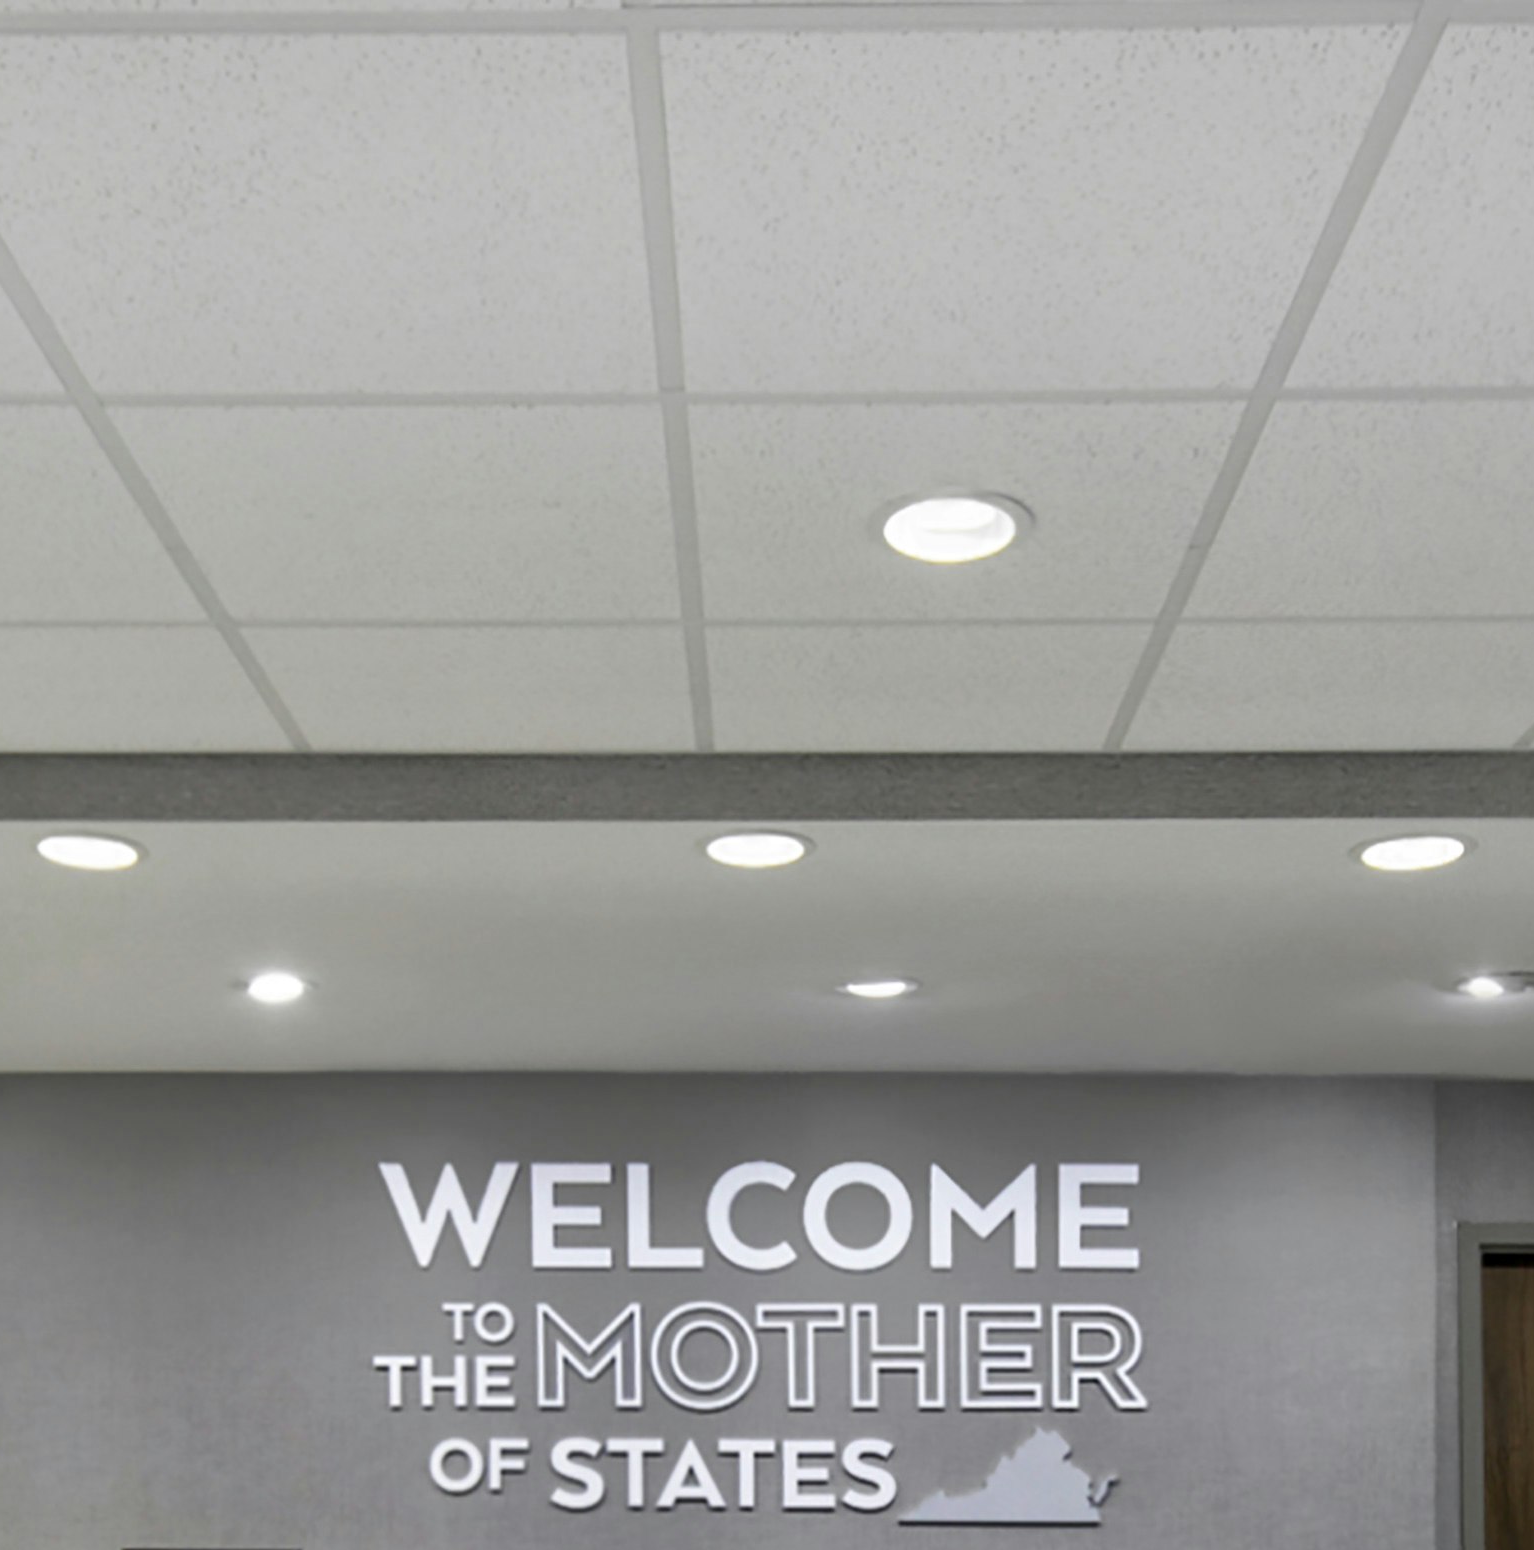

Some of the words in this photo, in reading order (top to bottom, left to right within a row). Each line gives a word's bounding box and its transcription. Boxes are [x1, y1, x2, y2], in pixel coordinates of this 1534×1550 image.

[379, 1161, 1140, 1270] WELCOME
[373, 1354, 515, 1409] THE
[536, 1301, 1148, 1411] MOTHER
[443, 1302, 514, 1342] TO
[429, 1437, 530, 1495] OF
[551, 1437, 897, 1511] STATES
